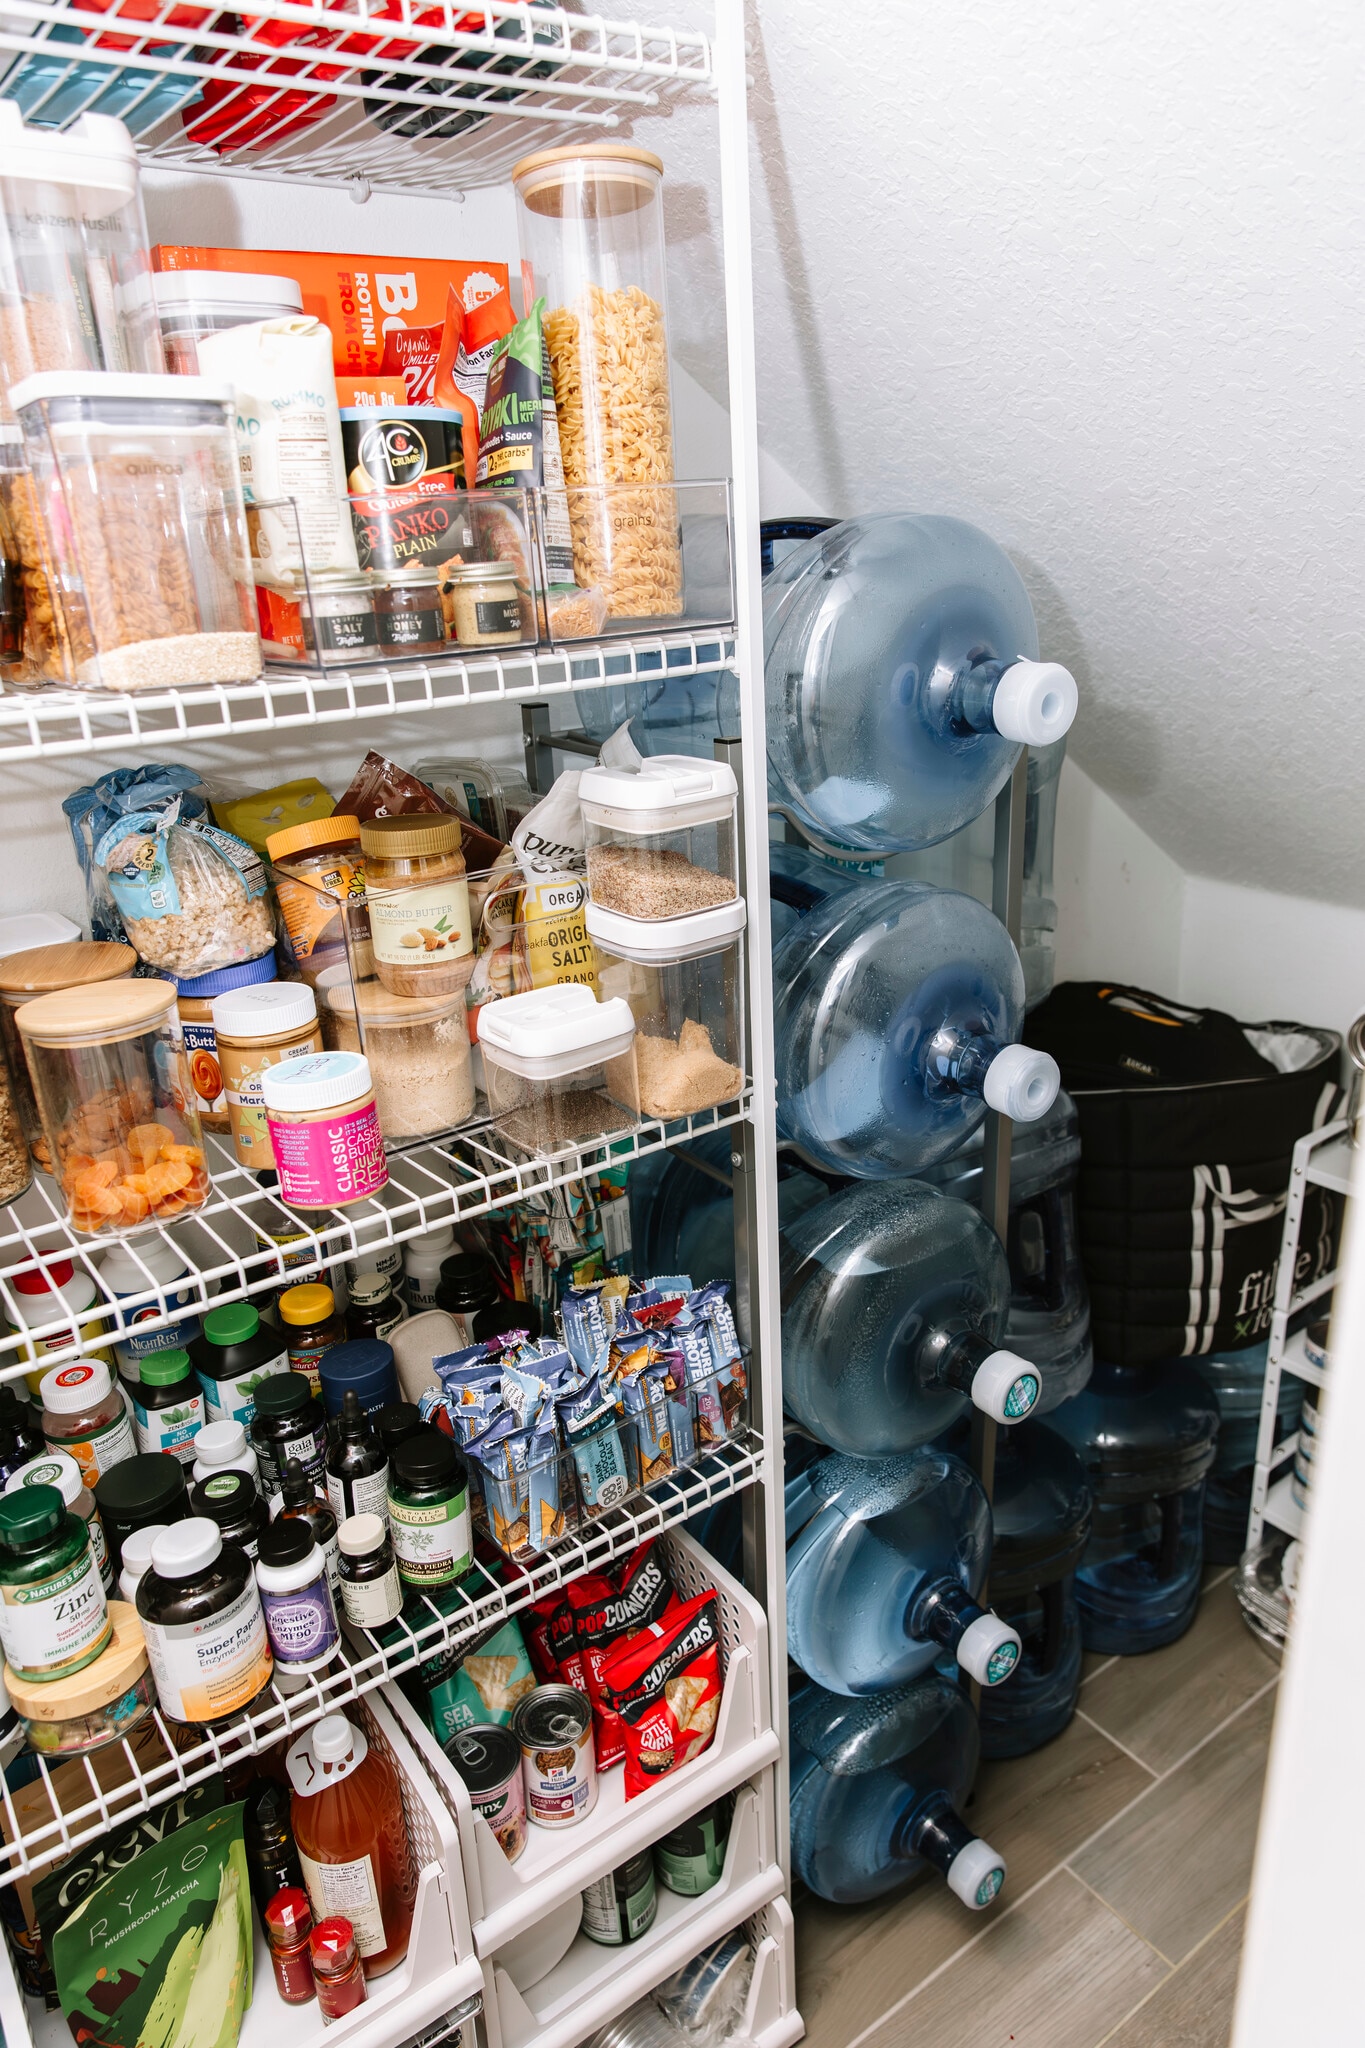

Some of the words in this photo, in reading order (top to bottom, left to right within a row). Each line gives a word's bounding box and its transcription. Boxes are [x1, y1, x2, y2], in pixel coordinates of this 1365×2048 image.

[24, 208, 78, 228] kaizen
[82, 212, 123, 233] fusilli
[337, 272, 359, 335] FROM
[354, 272, 377, 345] ROTINI
[396, 333, 430, 367] Organic
[272, 389, 326, 411] RUMMO
[520, 400, 543, 411] MEAL
[480, 392, 519, 441] RIYAKI
[520, 412, 535, 423] KIT
[505, 431, 533, 441] Sauce
[366, 428, 414, 482] 4C
[391, 454, 422, 467] CRUMBS
[126, 461, 184, 476] quinoa
[418, 482, 447, 494] Free
[364, 507, 449, 549] PANKO
[613, 512, 653, 531] grains
[393, 535, 438, 558] PLAIN
[333, 622, 363, 634] SALT
[387, 620, 423, 632] HONEY
[145, 849, 154, 861] 2
[324, 872, 337, 881] NUT
[325, 878, 341, 887] FREE
[375, 908, 413, 919] ALMOND
[416, 905, 453, 917] BUTTER
[514, 937, 556, 952] breakfast
[557, 971, 595, 984] GRANO
[288, 1045, 310, 1056] CREAMY
[344, 1121, 356, 1130] IT'S
[356, 1118, 367, 1126] REAL
[345, 1128, 357, 1136] IT'S
[357, 1124, 368, 1132] REAL
[347, 1123, 380, 1147] CASHE
[348, 1135, 381, 1159] BUTTE
[328, 1127, 352, 1192] CLASSIC
[352, 1158, 387, 1189] REA
[376, 1253, 397, 1267] HM-ET
[377, 1260, 397, 1273] Binder
[602, 1300, 613, 1325] CRISPY
[711, 1295, 736, 1358] PROTEIN
[685, 1333, 708, 1393] PROTEIN
[698, 1336, 714, 1379] PURE
[94, 1425, 124, 1448] Supplement
[176, 1429, 187, 1437] NO
[288, 1438, 312, 1458] gaia
[606, 1441, 615, 1458] SALT
[595, 1461, 605, 1484] DARK
[602, 1484, 618, 1505] 88
[424, 1559, 452, 1570] PIEDRA
[425, 1566, 451, 1574] Support
[29, 1574, 72, 1599] NATURE'S
[54, 1584, 96, 1621] Zinc
[577, 1560, 662, 1635] POPCORNERS
[69, 1613, 81, 1623] 50
[203, 1605, 240, 1630] AMERICAN
[269, 1610, 315, 1625] Digestive
[272, 1620, 315, 1633] Enzymes
[45, 1639, 80, 1658] IMMUNE
[82, 1617, 105, 1641] HEALTH
[56, 1620, 83, 1637] Supports
[58, 1628, 80, 1642] System
[197, 1636, 234, 1658] Super
[236, 1604, 262, 1639] Papaya
[199, 1646, 236, 1668] Enzyme
[236, 1634, 252, 1650] Plus
[613, 1617, 713, 1710] POPCORNERS
[209, 1688, 232, 1700] Advanced
[210, 1694, 238, 1709] Digestive
[444, 1704, 474, 1726] SEA
[473, 1801, 502, 1814] inx
[531, 1795, 560, 1805] DIGESTIVE
[104, 1905, 160, 1949] MUSHROOM
[161, 1879, 200, 1909] MATCHA
[281, 1964, 291, 1994] TRUFF
